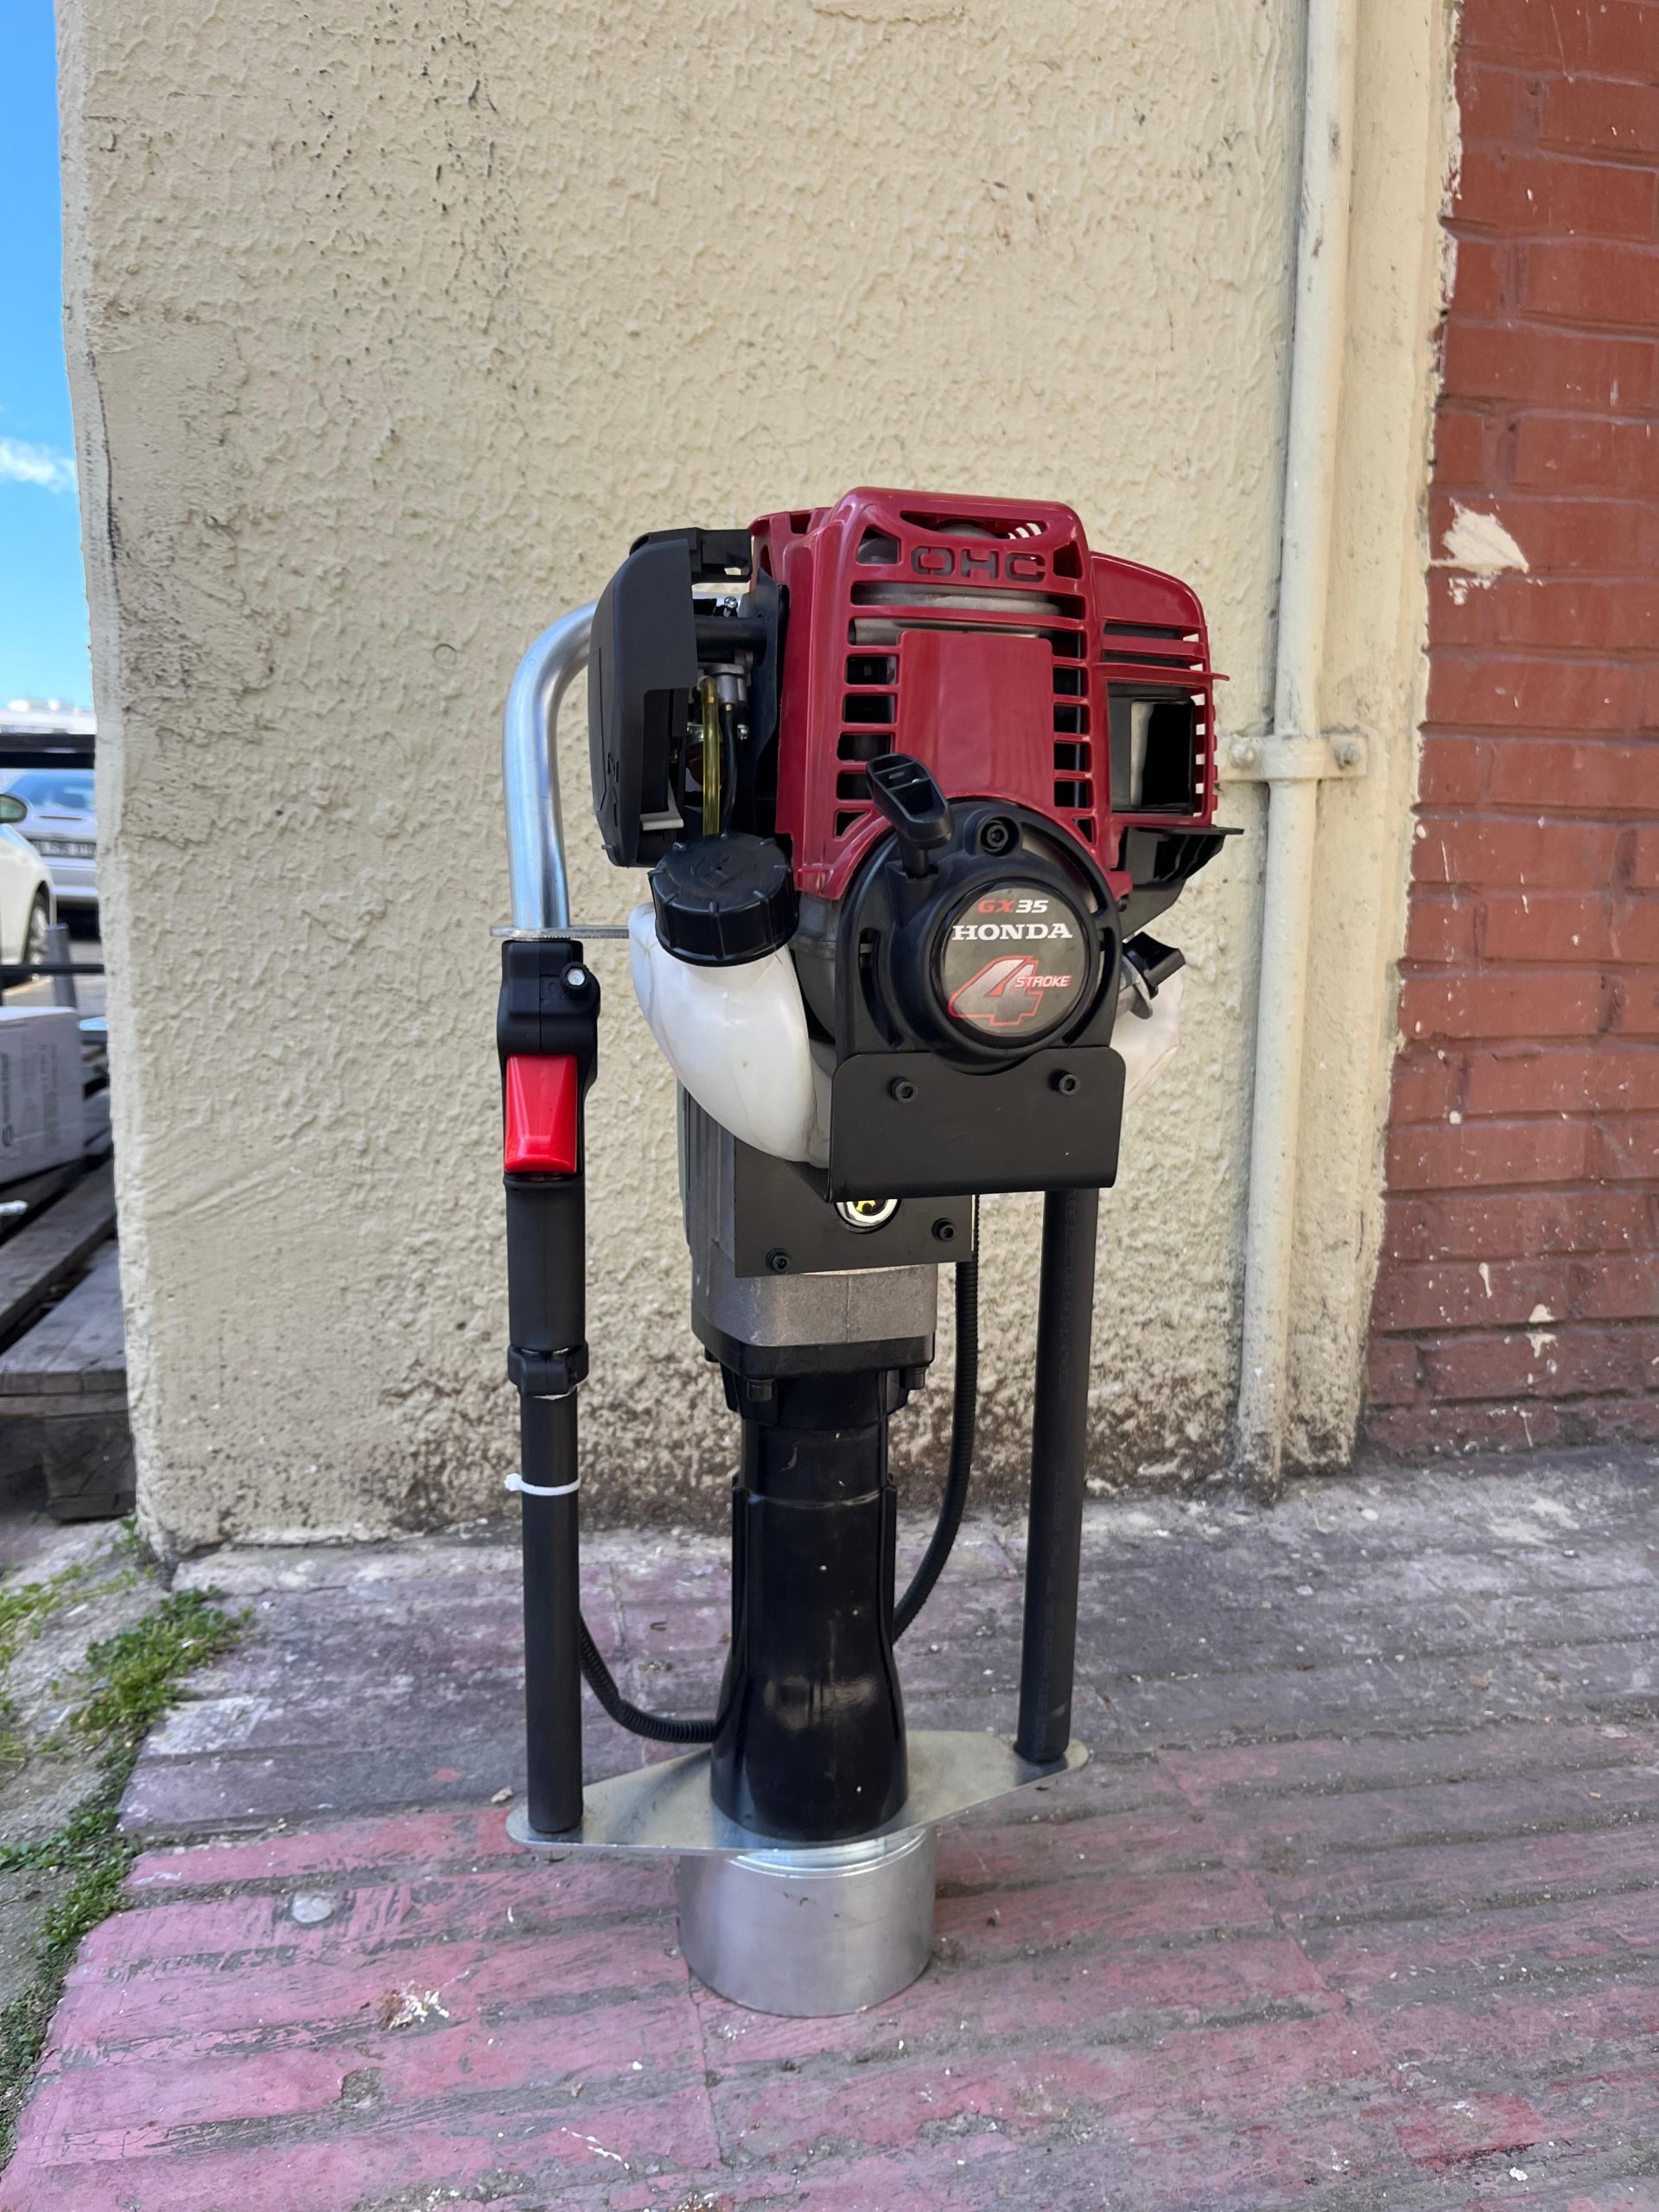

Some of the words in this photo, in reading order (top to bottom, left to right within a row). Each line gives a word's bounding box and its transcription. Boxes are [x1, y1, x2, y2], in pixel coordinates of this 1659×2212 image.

[912, 546, 1046, 582] OHC
[951, 923, 1073, 941] HONDA
[949, 955, 1044, 1026] 4
[1014, 976, 1071, 988] STROKE
